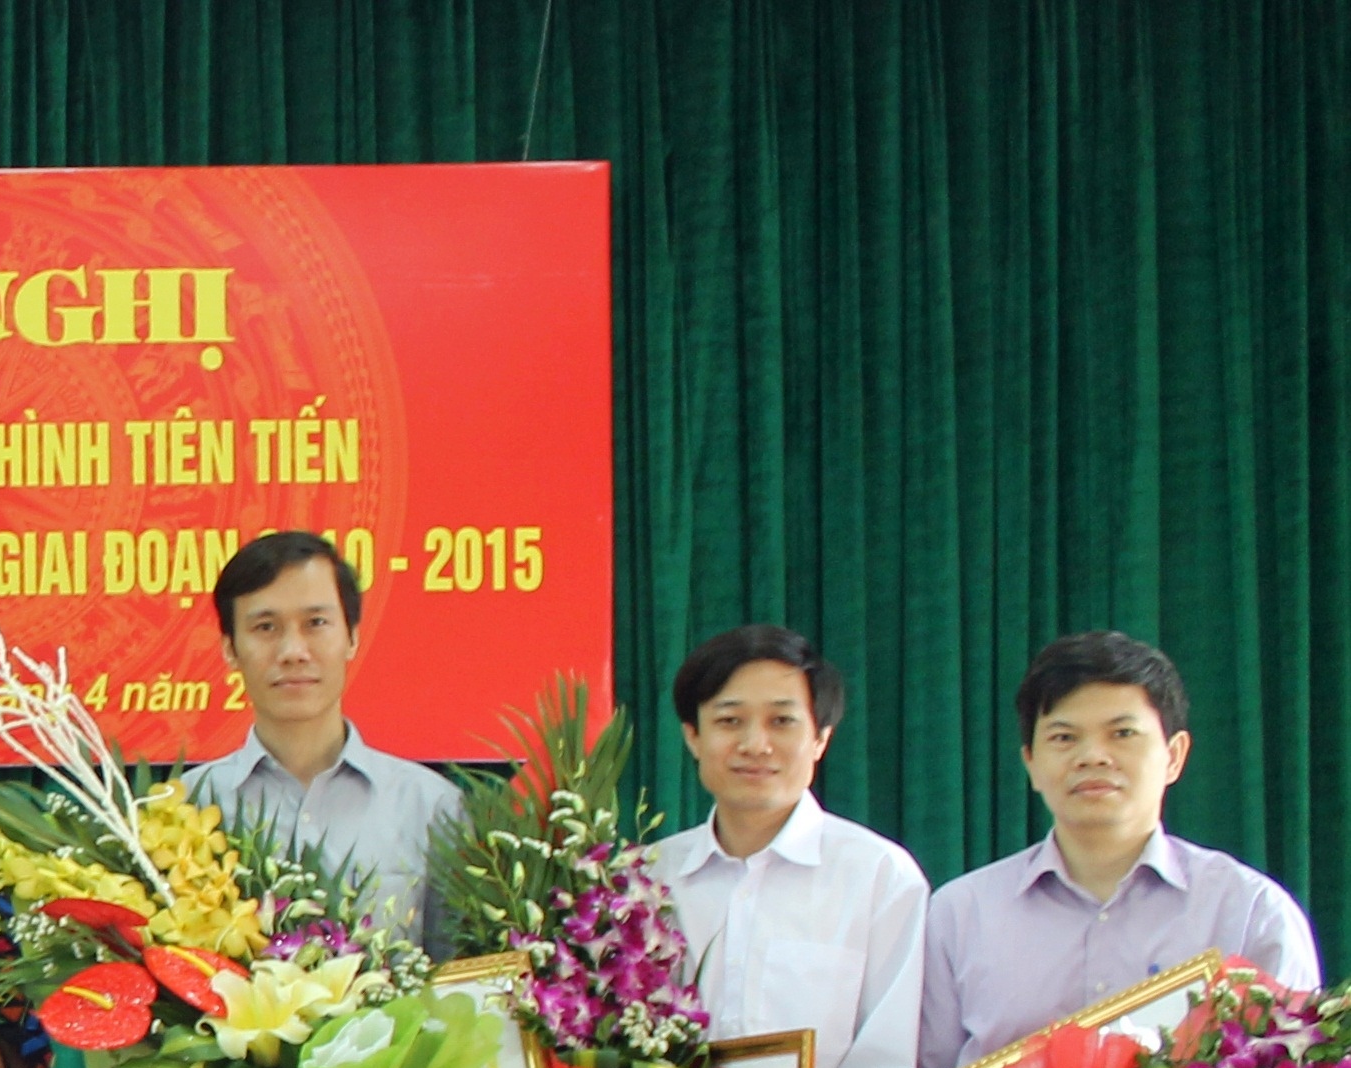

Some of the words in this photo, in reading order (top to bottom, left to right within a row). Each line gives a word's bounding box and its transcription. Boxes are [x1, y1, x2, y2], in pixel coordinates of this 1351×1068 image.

[124, 405, 235, 486] TIÊN
[249, 395, 360, 484] TIẾN
[102, 527, 239, 609] ĐOẠN
[423, 526, 544, 593] 2015
[83, 672, 109, 712] 4
[120, 672, 211, 713] năm
